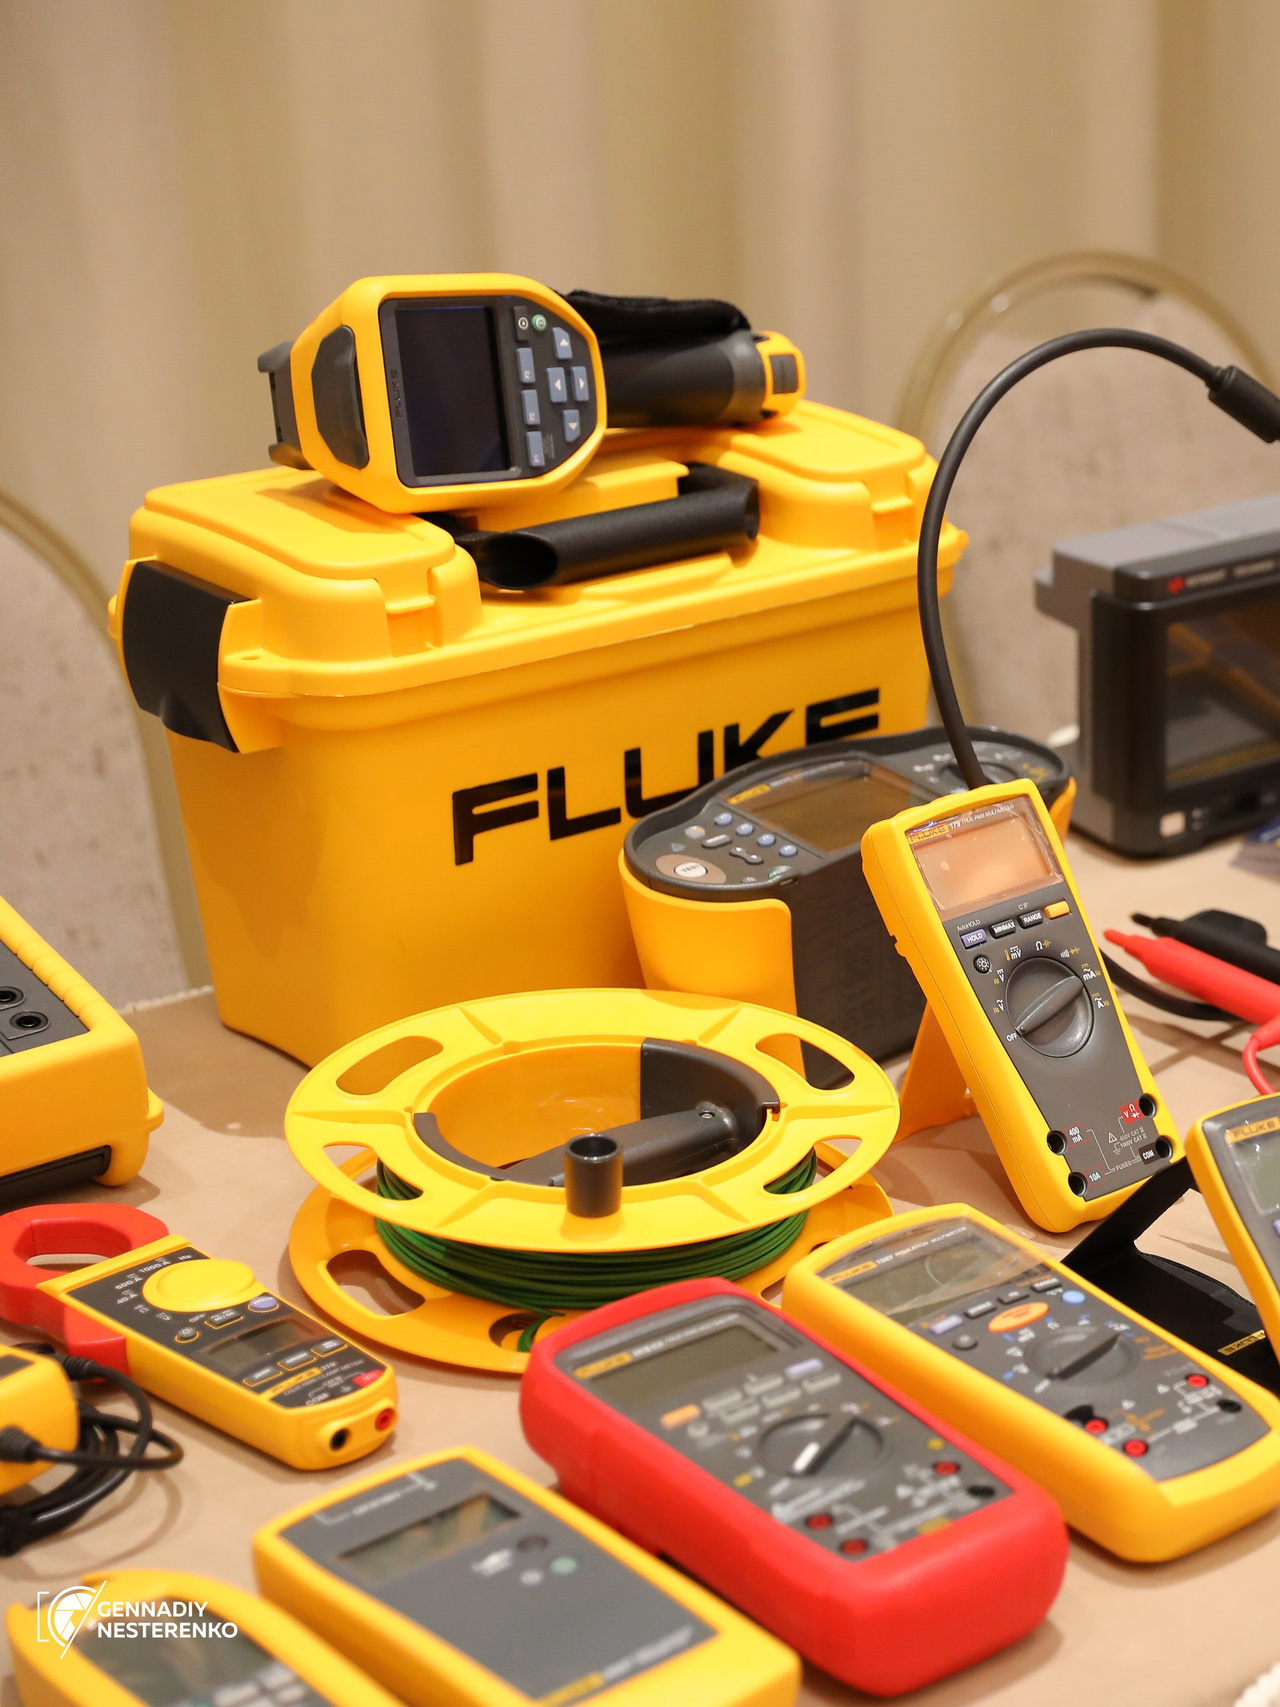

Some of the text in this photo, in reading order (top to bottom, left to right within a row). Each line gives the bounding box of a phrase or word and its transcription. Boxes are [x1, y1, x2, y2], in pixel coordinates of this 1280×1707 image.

[909, 825, 947, 842] FLUKE
[949, 820, 960, 830] 179
[682, 865, 699, 873] TEST
[1023, 912, 1042, 924] RANGE
[957, 919, 981, 931] AutoHOLD
[993, 921, 1016, 934] MINMAX
[966, 932, 983, 943] HOLD
[1006, 1032, 1018, 1041] OFF
[1068, 1126, 1080, 1136] 400
[1233, 1120, 1276, 1138] FLUKE
[1072, 1135, 1083, 1144] mA
[1120, 1140, 1133, 1148] 1000V
[1143, 1149, 1155, 1160] COM
[1116, 1160, 1132, 1171] FUSED
[1089, 1172, 1102, 1182] 10A
[139, 1262, 161, 1273] 1000
[115, 1280, 133, 1290] 600
[252, 1295, 273, 1305] HOLD
[188, 1313, 206, 1323] OFF
[305, 1392, 330, 1406] COM
